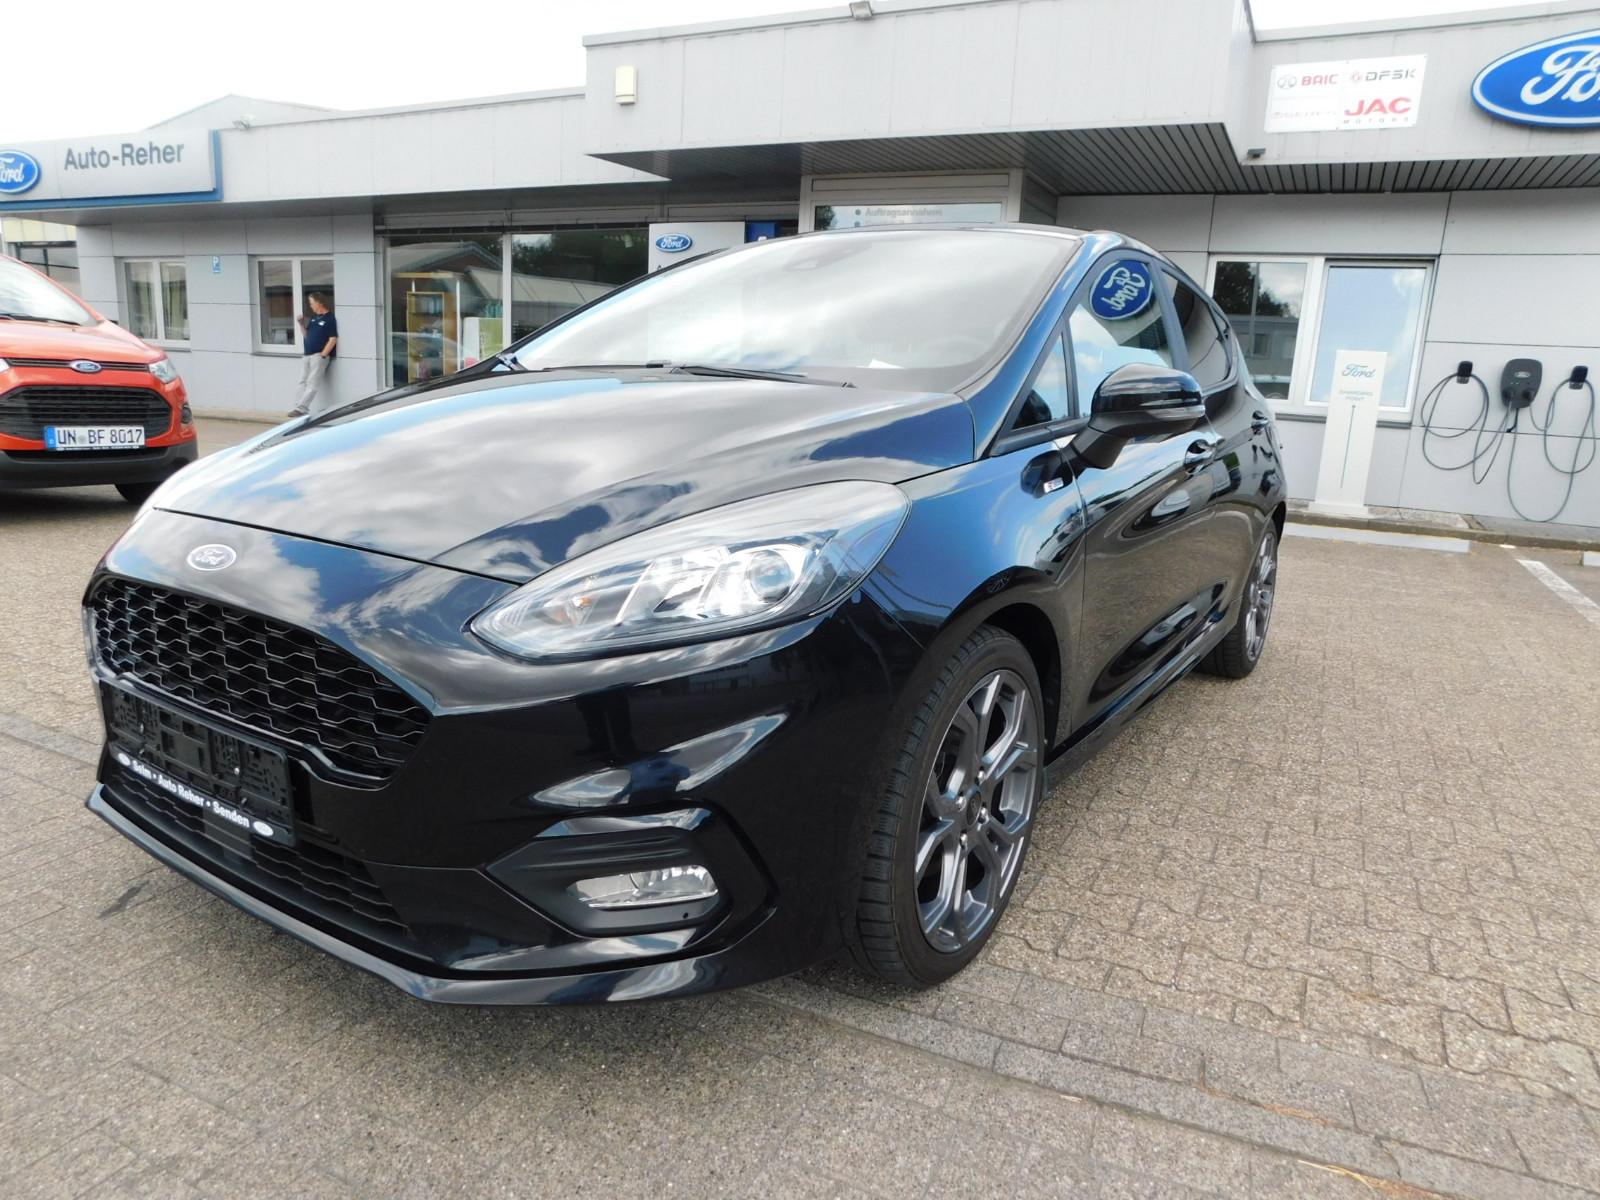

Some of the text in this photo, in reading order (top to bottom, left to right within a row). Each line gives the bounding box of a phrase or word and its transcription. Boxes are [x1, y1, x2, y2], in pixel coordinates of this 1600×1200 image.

[1301, 74, 1339, 86] BAIC
[1365, 68, 1416, 82] DFSK
[1344, 96, 1411, 116] JAC
[64, 142, 185, 170] Auto-Reher
[660, 236, 684, 249] Ford
[1342, 363, 1376, 378] Ford
[57, 428, 142, 445] UN BF 8017
[157, 774, 177, 793] Auto
[178, 784, 205, 807] Reher
[212, 800, 250, 828] Senden
